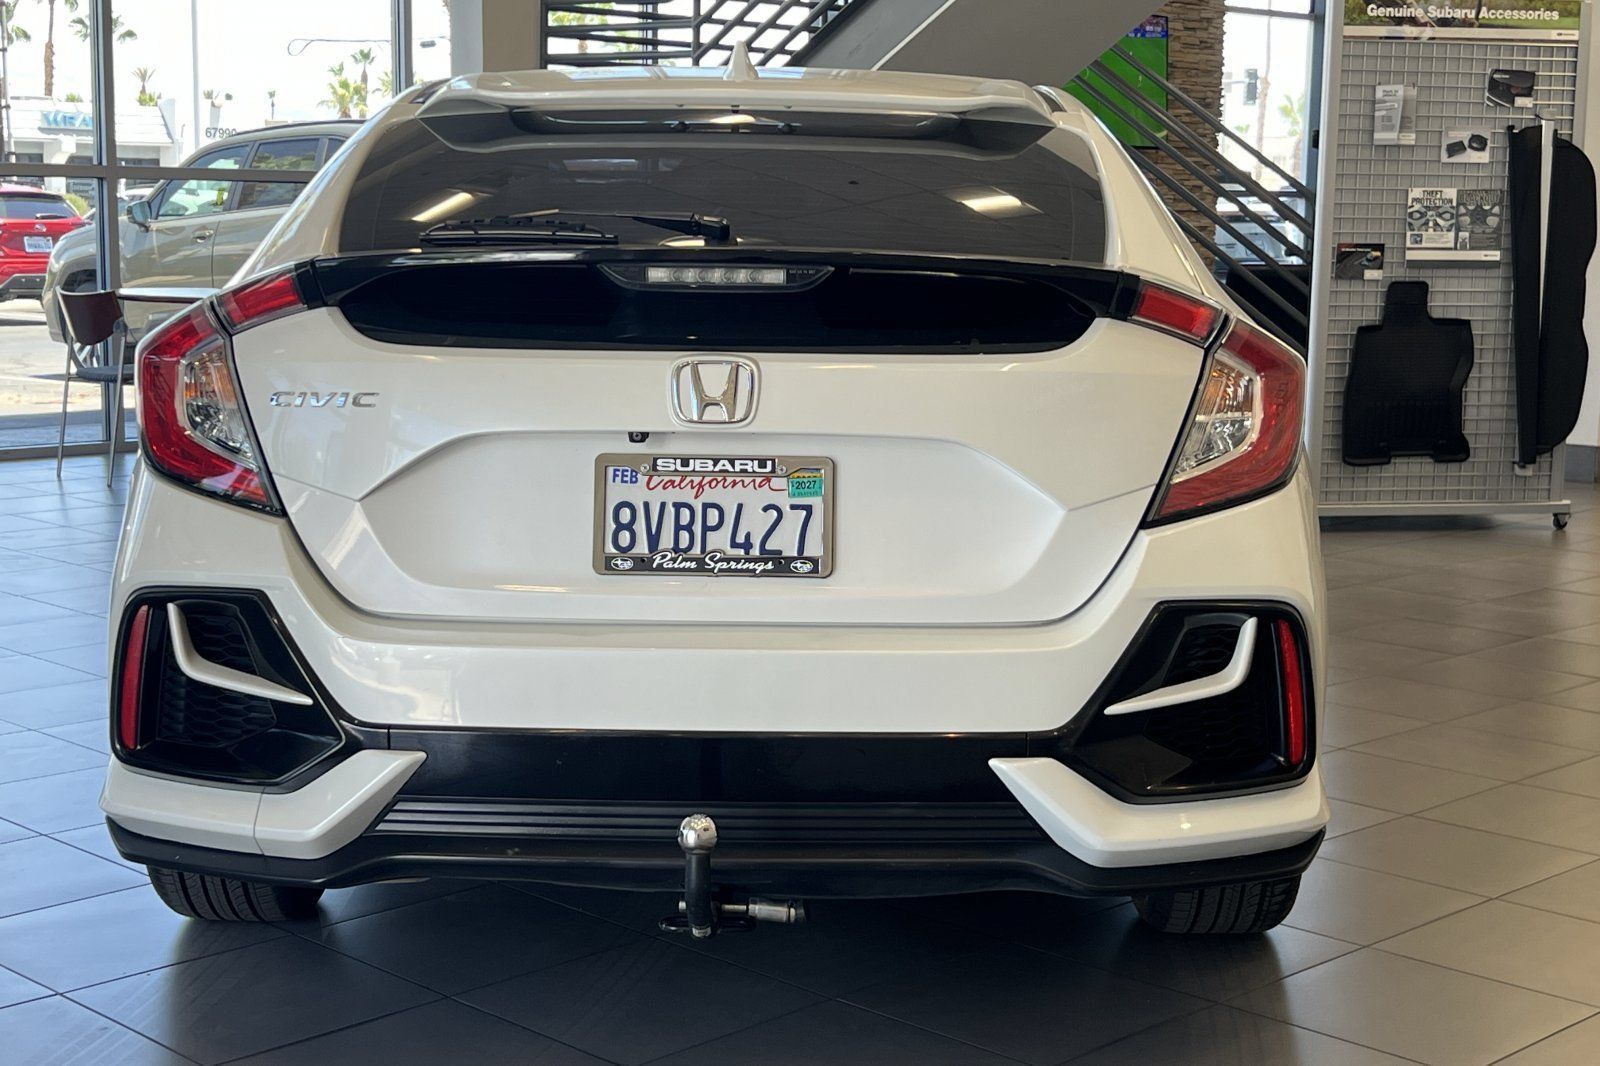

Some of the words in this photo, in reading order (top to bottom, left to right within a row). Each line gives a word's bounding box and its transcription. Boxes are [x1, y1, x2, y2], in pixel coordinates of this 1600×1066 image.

[1366, 4, 1423, 18] Genuine
[1427, 6, 1475, 19] Subaru
[1478, 7, 1560, 21] Accessories
[1411, 197, 1453, 206] PROTECTION
[1422, 190, 1443, 198] THEFT
[270, 391, 380, 408] CIVIC
[656, 458, 773, 473] SUBARU
[612, 468, 639, 484] FEB
[645, 475, 788, 499] California
[795, 480, 817, 490] 2027
[611, 500, 813, 556] 8VBP427
[652, 551, 698, 569] Palm
[704, 552, 774, 574] Springs
